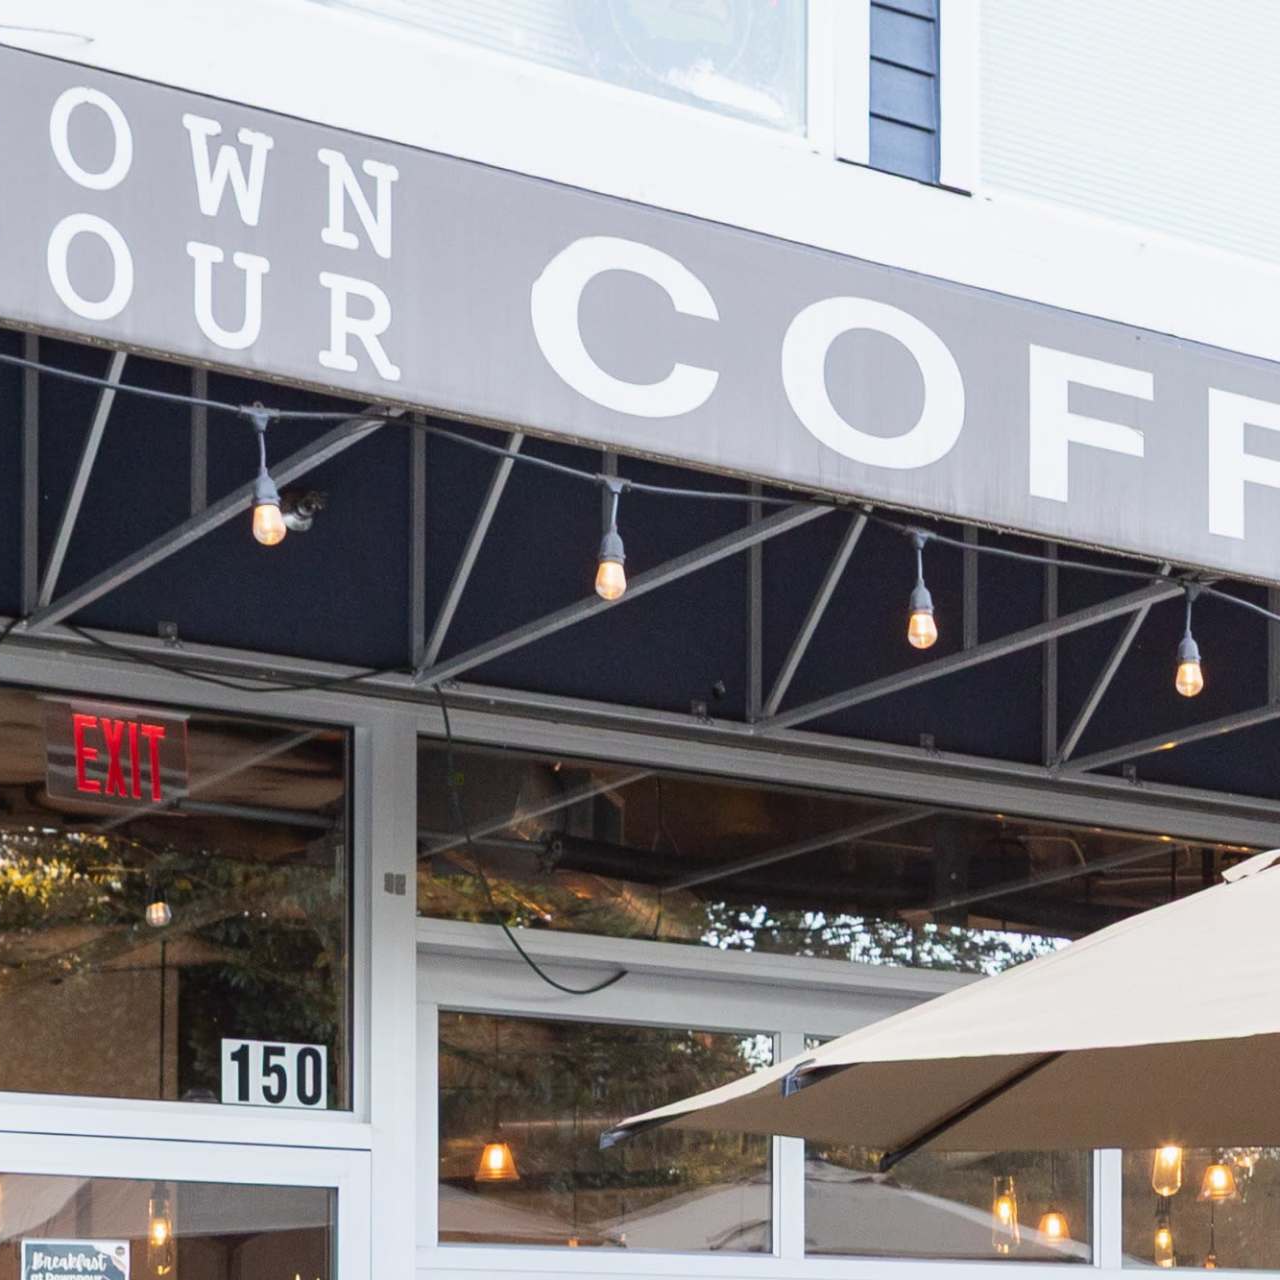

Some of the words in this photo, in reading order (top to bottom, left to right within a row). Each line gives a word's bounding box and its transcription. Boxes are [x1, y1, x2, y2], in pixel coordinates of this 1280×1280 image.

[72, 714, 166, 801] EXIT
[230, 1044, 322, 1106] 150
[33, 1252, 107, 1271] Breakfast
